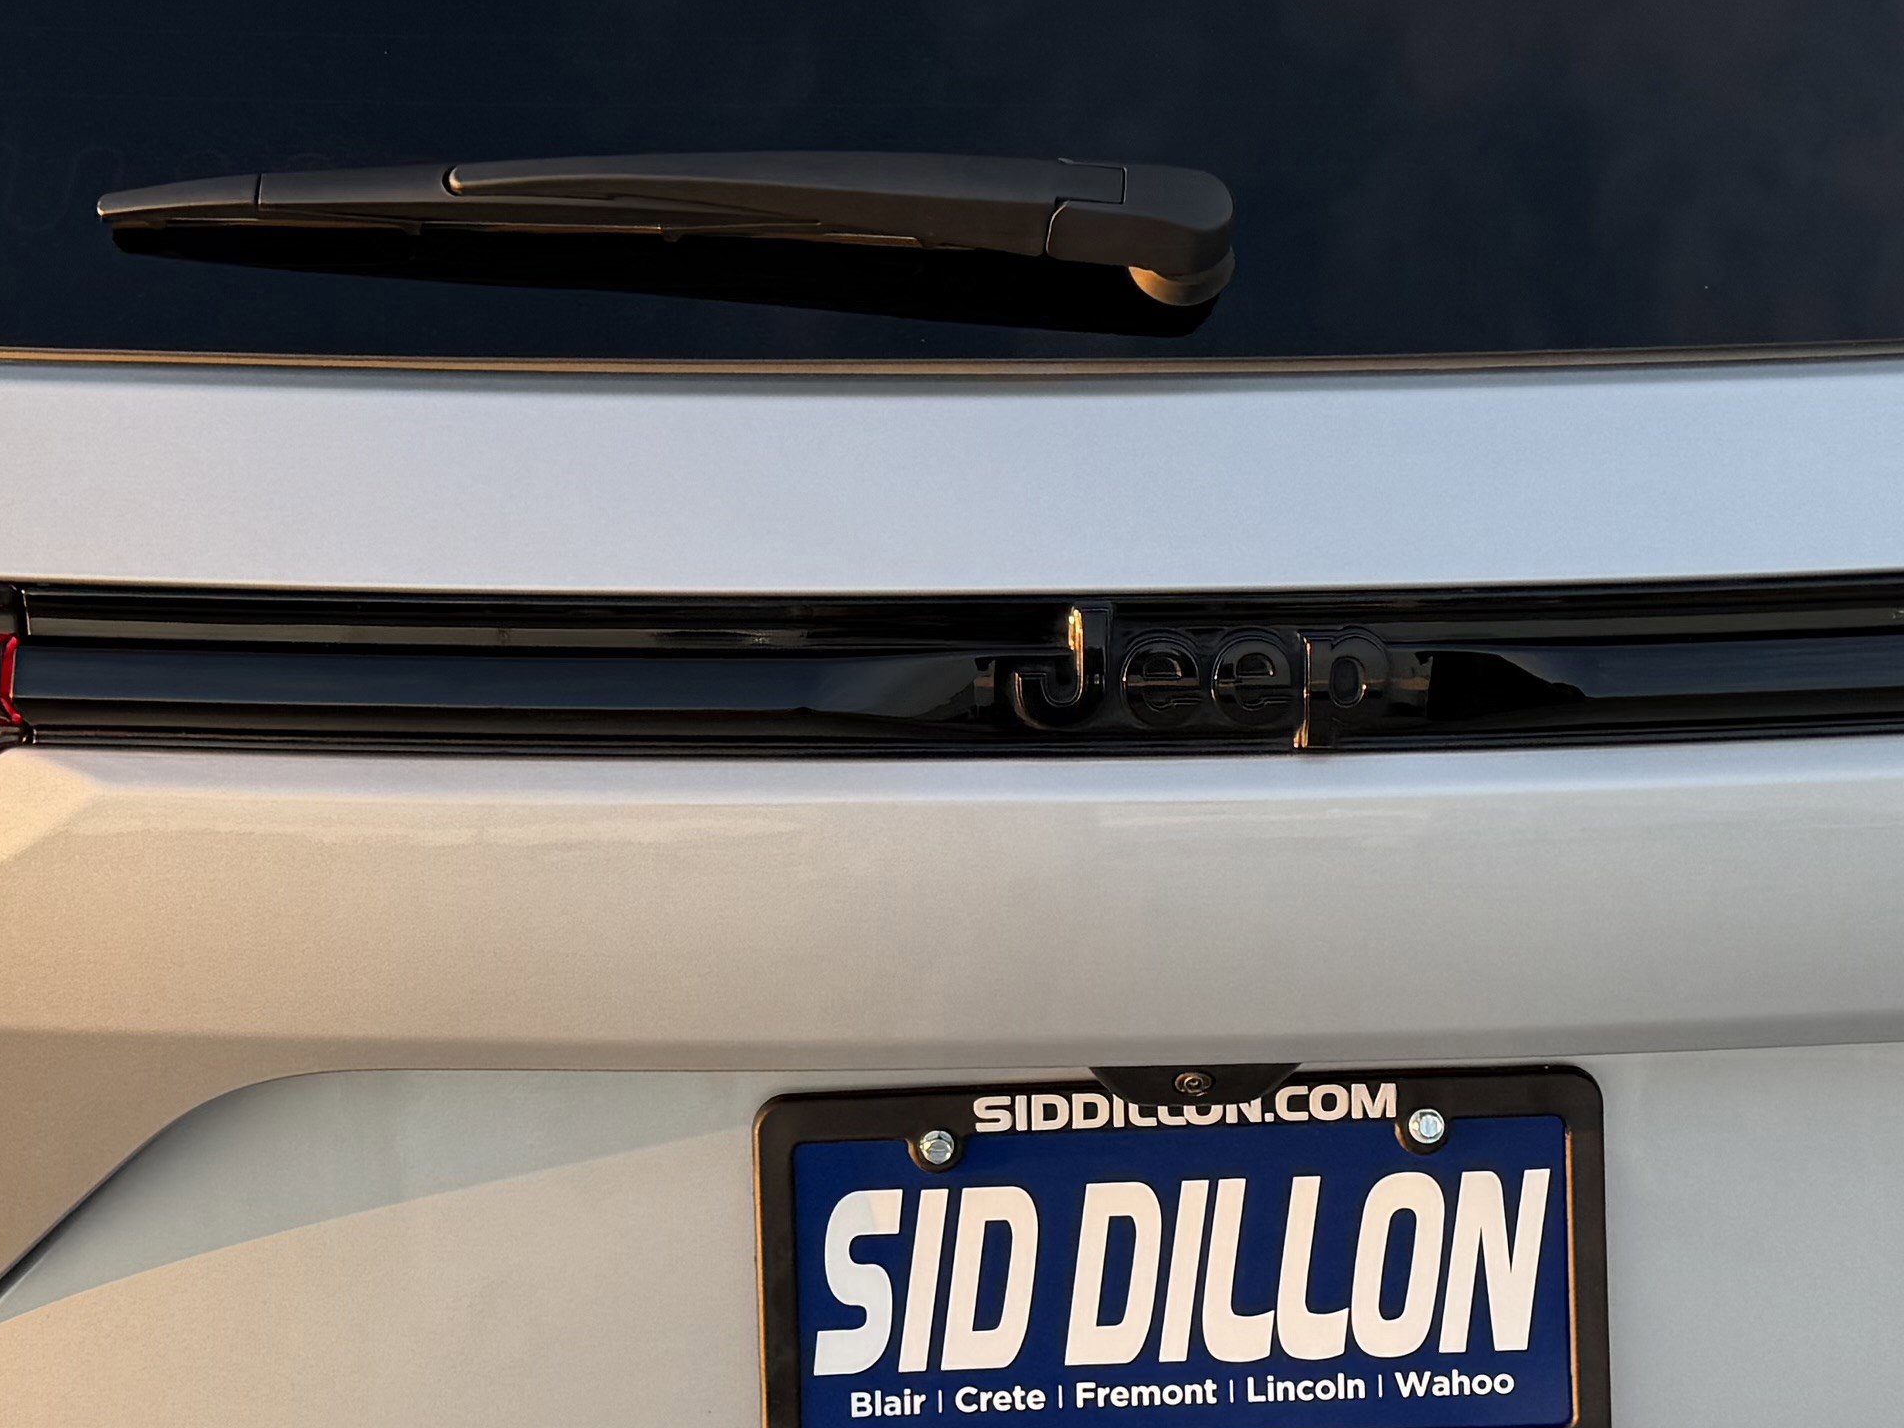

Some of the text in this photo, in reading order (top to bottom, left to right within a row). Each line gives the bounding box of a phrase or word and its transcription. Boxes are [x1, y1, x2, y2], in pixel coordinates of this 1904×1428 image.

[1013, 601, 1394, 749] Jeep
[812, 1167, 1553, 1377] SID DILLON
[849, 1388, 927, 1419] Blair
[954, 1385, 1047, 1414] Crete
[1074, 1378, 1218, 1409] Fremont
[1246, 1373, 1367, 1404] Lincoln
[1394, 1368, 1516, 1399] Wahoo
